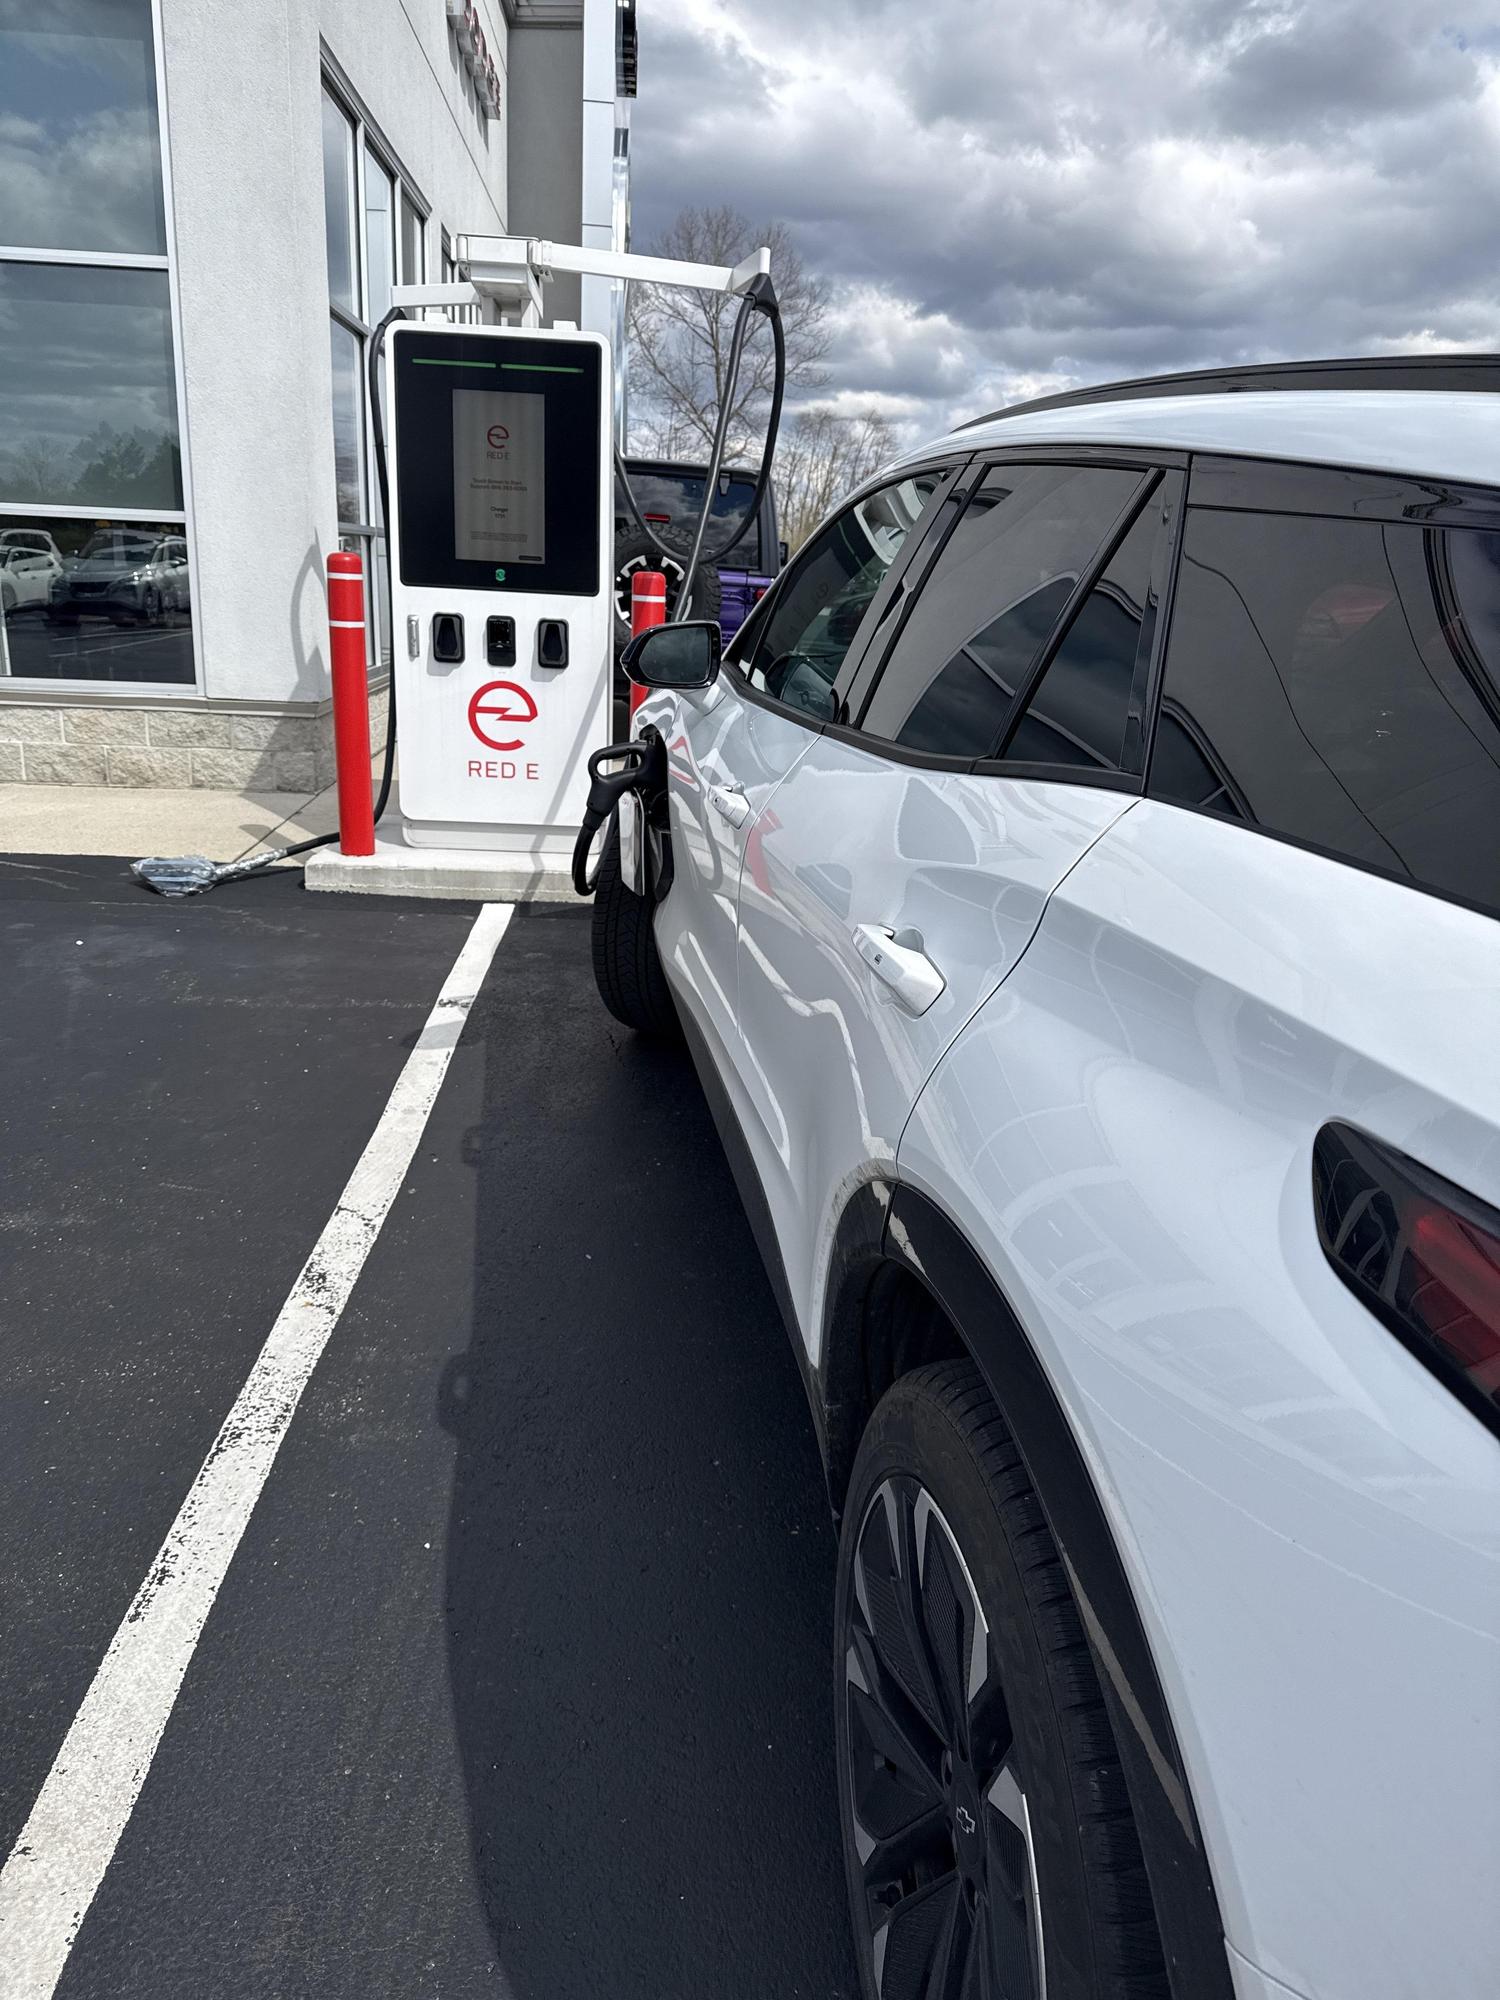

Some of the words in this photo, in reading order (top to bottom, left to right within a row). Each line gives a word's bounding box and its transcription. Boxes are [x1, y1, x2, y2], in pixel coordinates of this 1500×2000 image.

[486, 451, 504, 460] RED
[468, 760, 516, 779] RED
[526, 763, 539, 780] E
